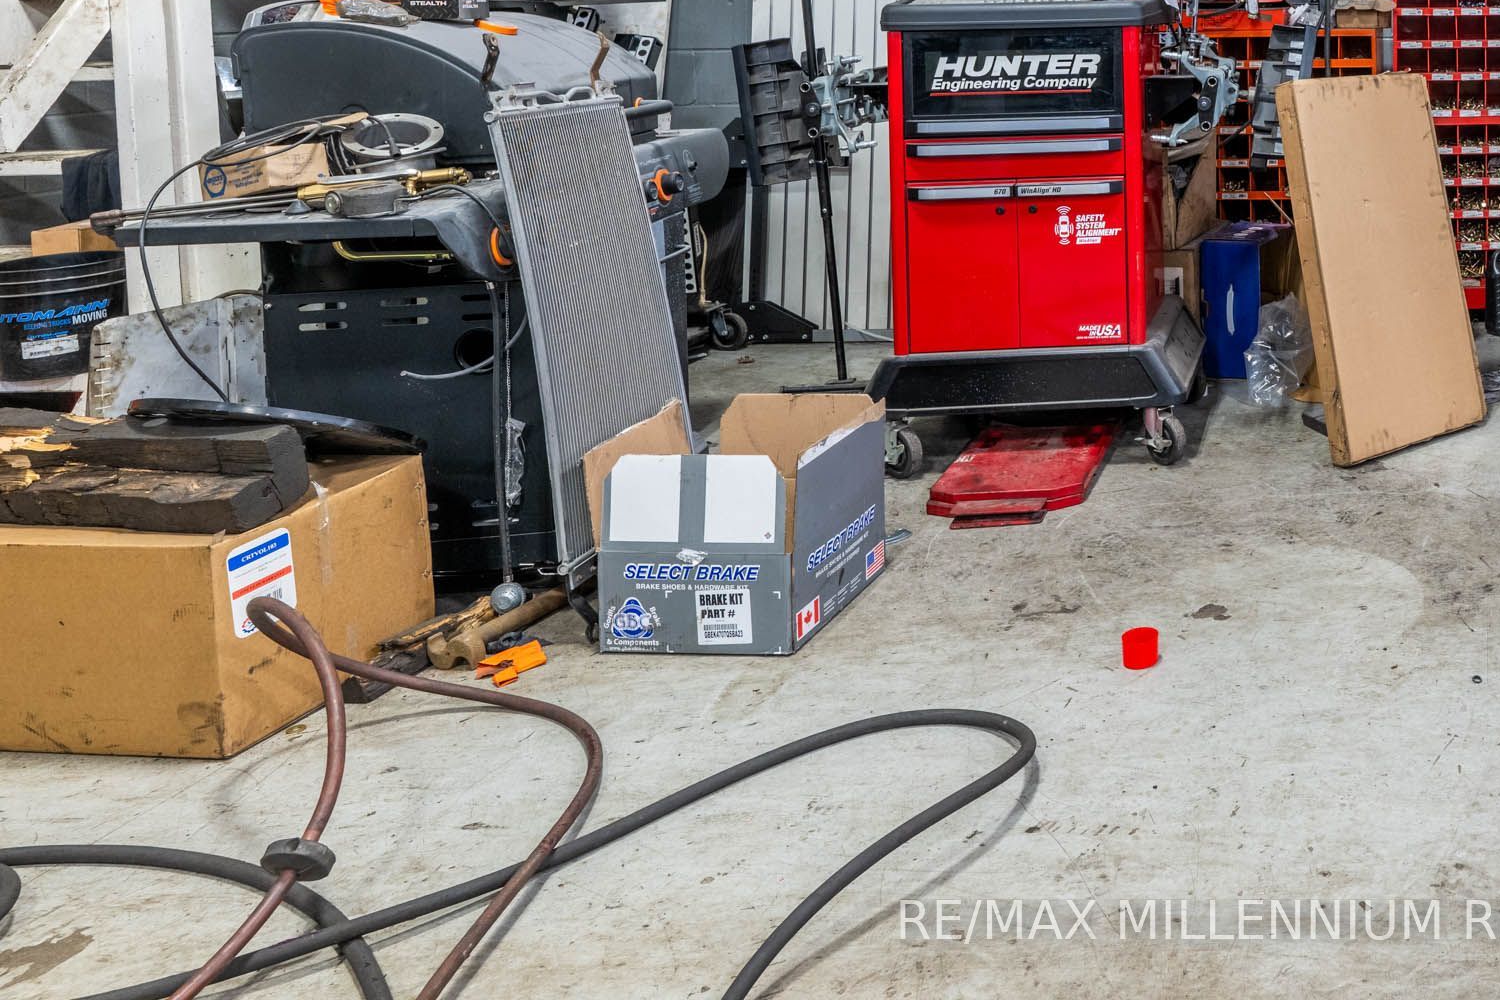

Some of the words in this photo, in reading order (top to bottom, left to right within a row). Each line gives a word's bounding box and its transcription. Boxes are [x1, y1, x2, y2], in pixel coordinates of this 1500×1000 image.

[934, 54, 1101, 78] HUNTER
[931, 77, 1021, 92] Engineering
[1023, 76, 1097, 90] Company
[1075, 214, 1104, 222] SAFETY
[1075, 221, 1106, 230] SYSTEM
[72, 308, 108, 326] MOVING
[1096, 324, 1121, 336] USA
[807, 528, 847, 573] SELECT
[623, 563, 694, 581] SELECT
[694, 564, 760, 582] BRAKE
[635, 582, 660, 590] BRAKE
[661, 583, 686, 591] SHOES
[699, 593, 728, 607] BRAKE
[729, 592, 744, 605] KIT
[701, 608, 726, 619] PART
[727, 609, 736, 618] #
[613, 638, 660, 646] Components
